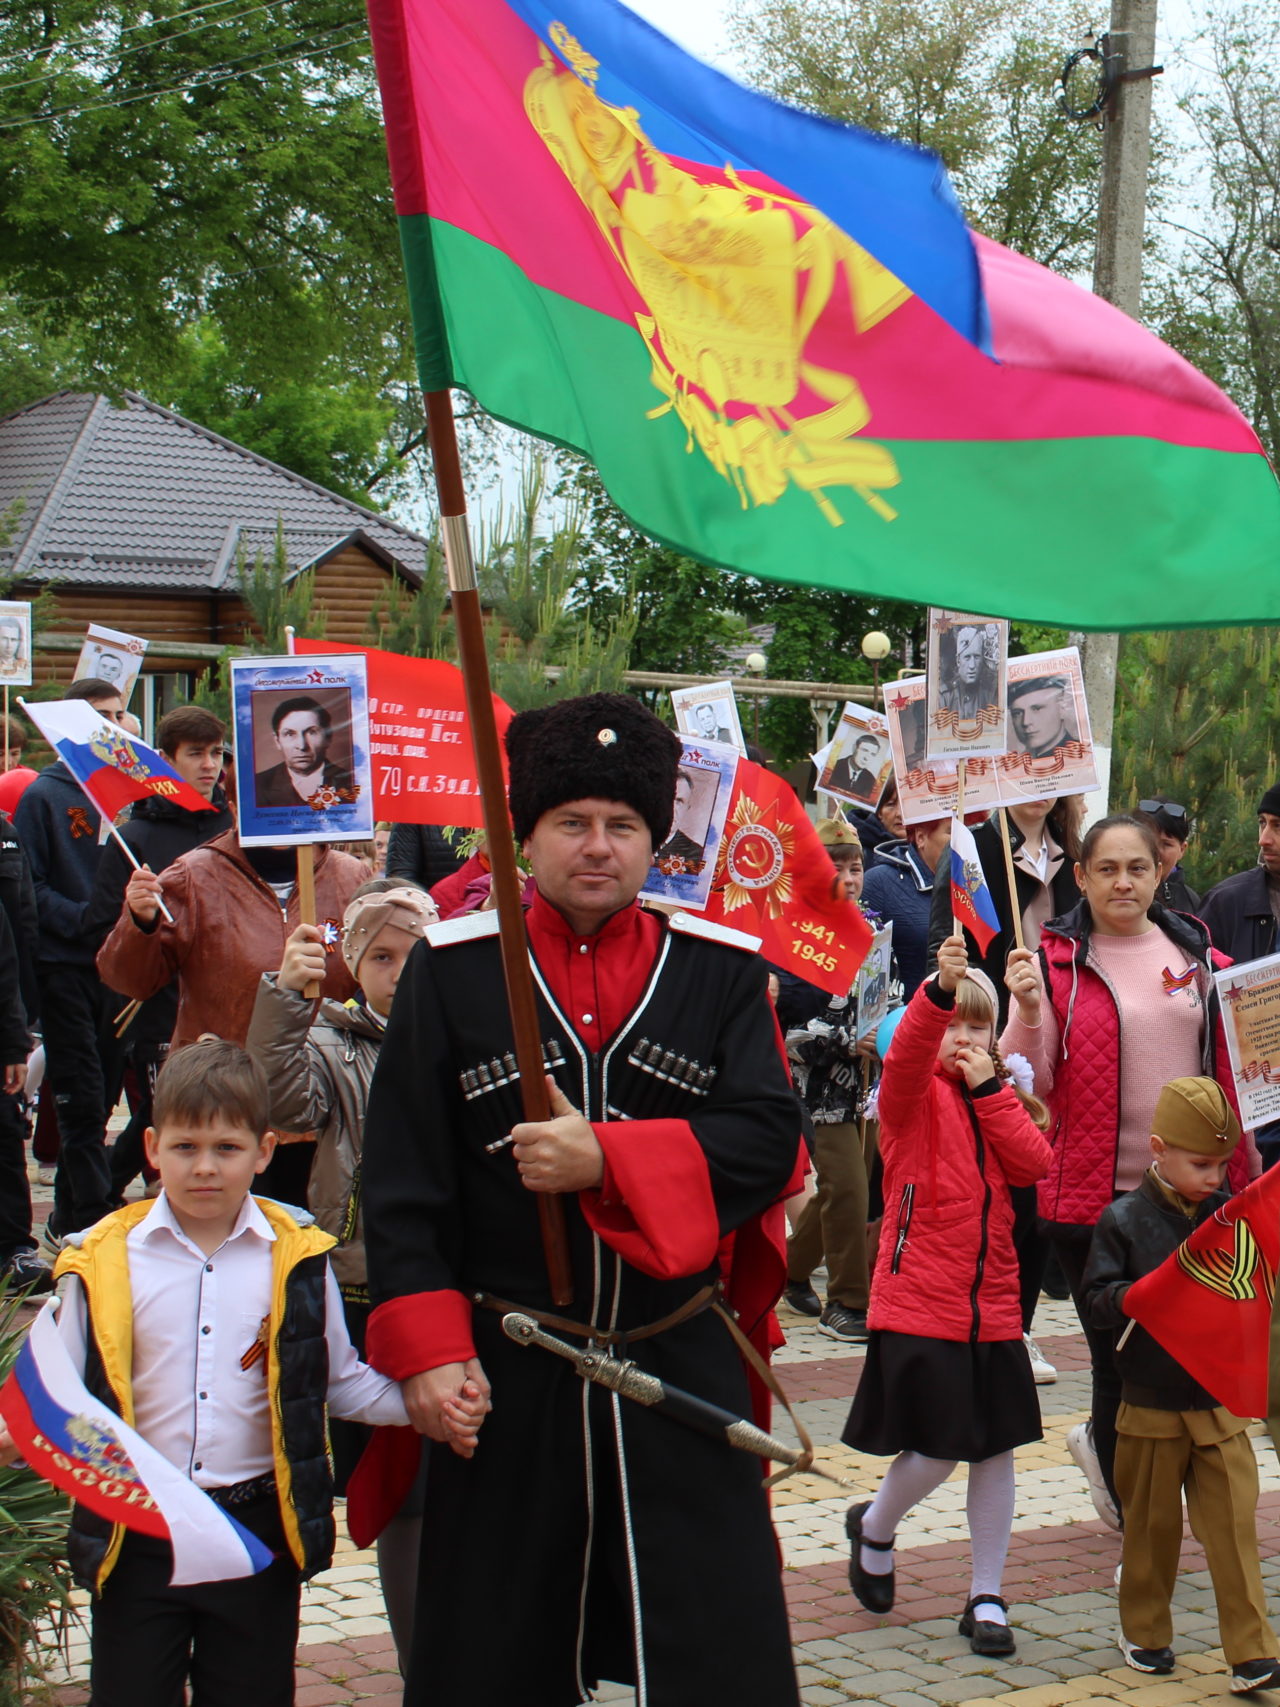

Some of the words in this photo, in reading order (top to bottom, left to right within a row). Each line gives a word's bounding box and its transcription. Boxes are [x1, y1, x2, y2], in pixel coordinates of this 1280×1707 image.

[380, 765, 402, 797] 79
[728, 825, 781, 874] ОТЕЧЕСТВЕННАЯ
[753, 858, 782, 886] ВОЙНА
[953, 888, 977, 921] ОССИЯ
[791, 918, 836, 946] 941
[791, 939, 838, 972] 1945
[1235, 1001, 1258, 1013] Семен
[31, 1433, 162, 1514] РОССИ
